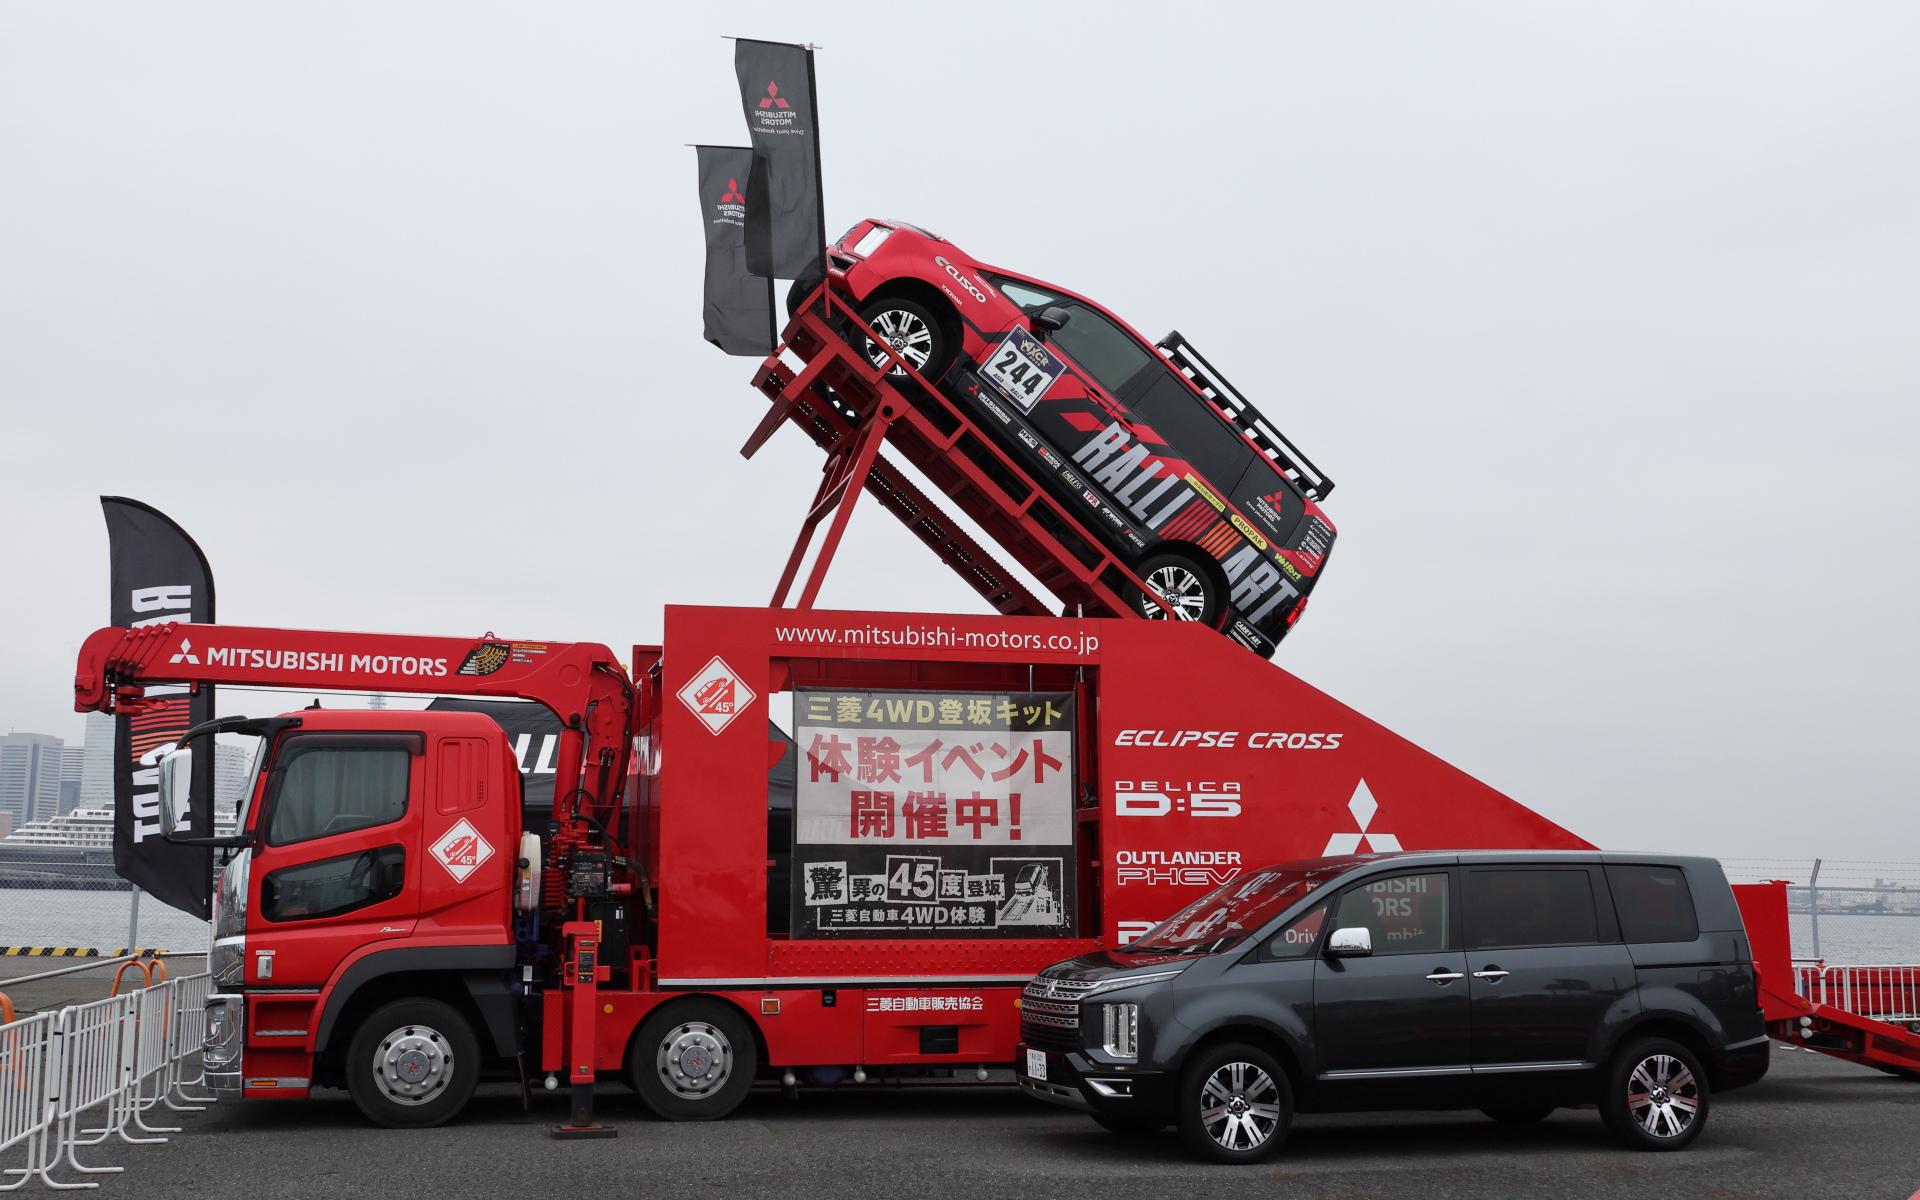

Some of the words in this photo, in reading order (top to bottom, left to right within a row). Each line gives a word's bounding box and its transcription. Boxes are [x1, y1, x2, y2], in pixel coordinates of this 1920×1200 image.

[946, 265, 986, 304] CUSCO
[994, 350, 1044, 396] 244
[1010, 388, 1025, 401] RALLY
[1046, 452, 1060, 468] ENEOS
[1072, 421, 1196, 530] RALLI
[1085, 492, 1100, 506] TPR
[1256, 496, 1282, 522] MITSUBISHI
[1256, 503, 1276, 522] MOTORS
[1234, 517, 1264, 547] PROPAK
[1222, 545, 1300, 625] ART
[775, 625, 1100, 656] www.mitsubishi-motors.co.jp
[1236, 620, 1252, 637] CARRY
[1251, 632, 1262, 646] ART
[206, 646, 345, 674] MITSUBISHI
[350, 654, 448, 677] MOTORS
[715, 701, 734, 714] 45°
[807, 696, 1062, 726] 三菱4WD登坂キット
[1114, 730, 1240, 748] ECLIPSE
[1247, 732, 1344, 750] CROSS
[806, 733, 1063, 784] 体験イベント
[1115, 781, 1240, 792] DELICA
[1116, 792, 1242, 817] D:5
[460, 855, 476, 866] 45°
[1116, 850, 1242, 866] OUTLANDER
[809, 862, 1002, 902] 驚異の45度登坂
[1117, 868, 1242, 886] PHEV
[831, 906, 986, 924] 三菱自動車4WD体験
[866, 996, 984, 1012] 三菱自動車販売協会
